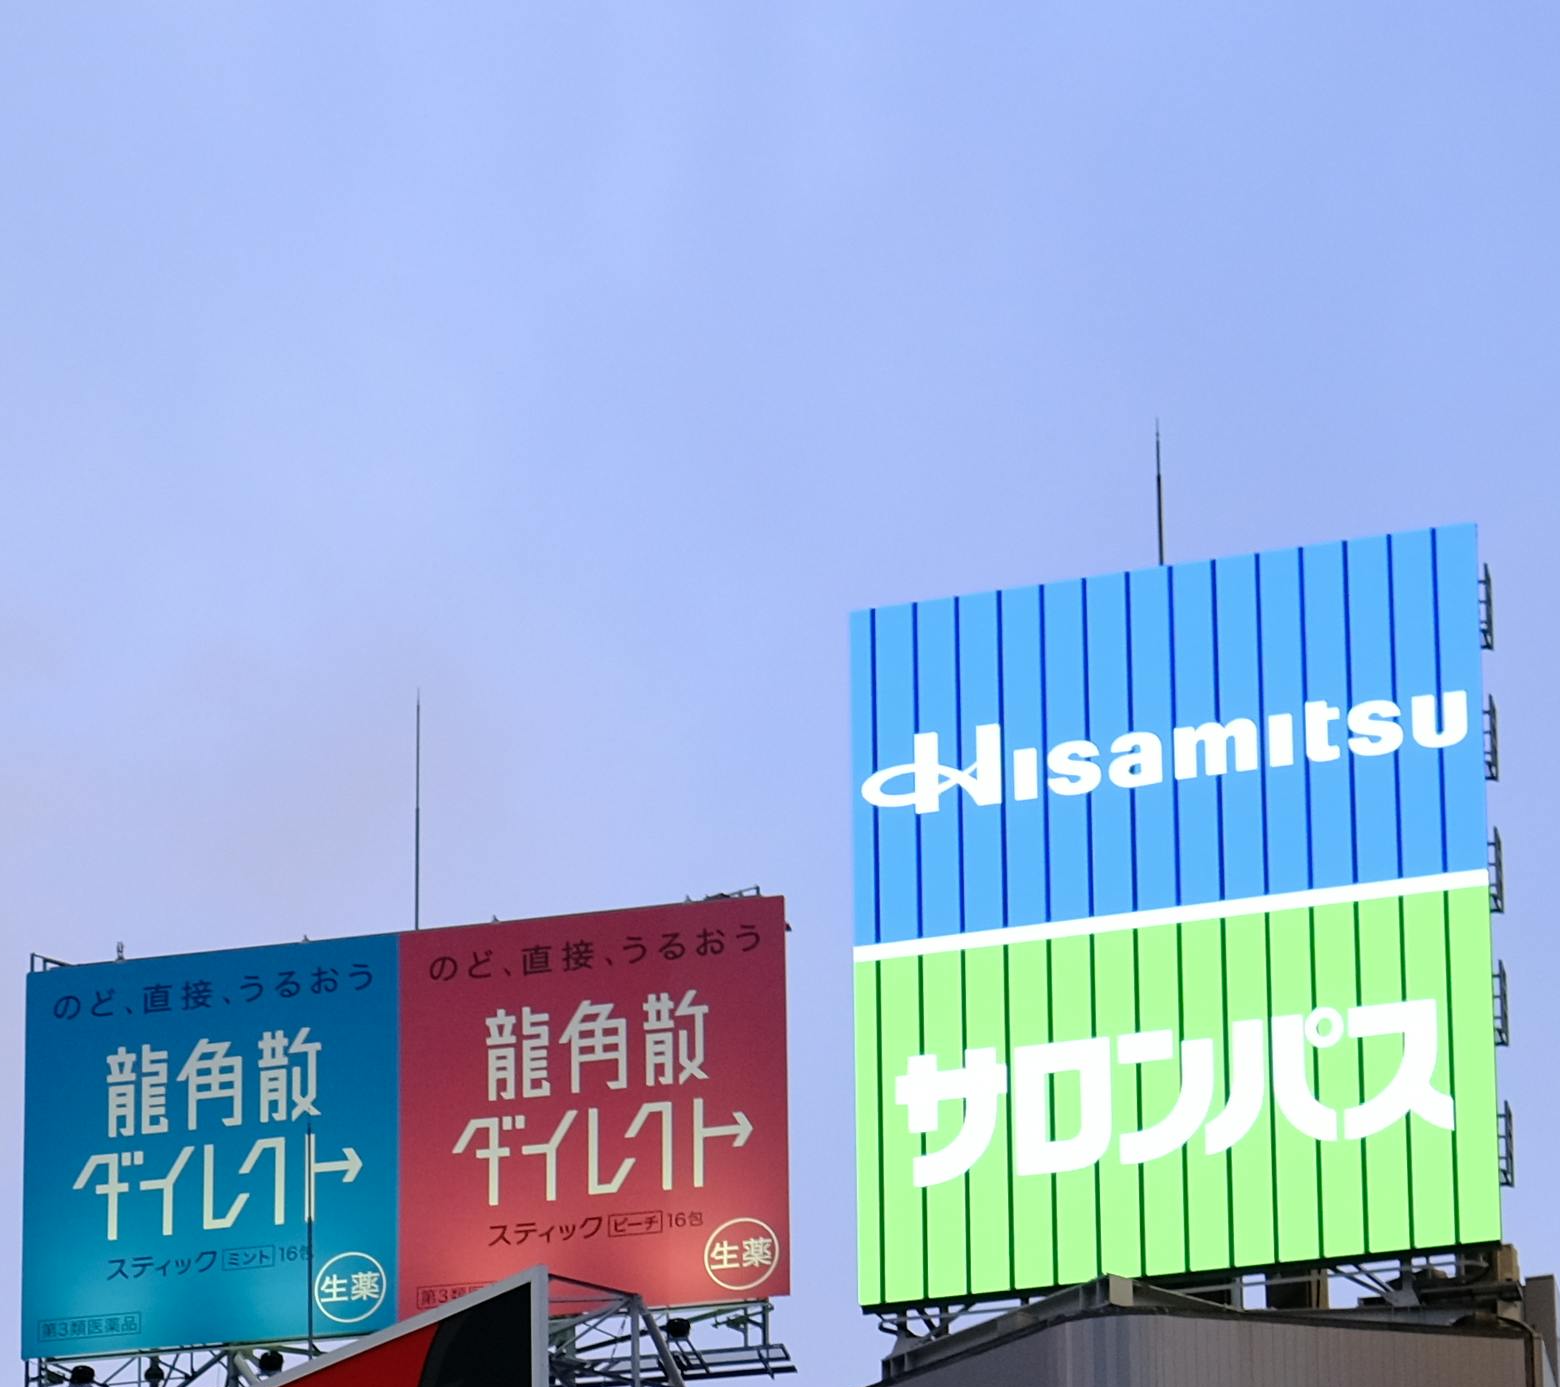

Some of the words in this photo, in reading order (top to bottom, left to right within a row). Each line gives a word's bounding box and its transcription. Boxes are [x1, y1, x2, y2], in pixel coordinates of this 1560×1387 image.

[861, 692, 1470, 814] Hisamitsu
[428, 924, 763, 982] のど、直接、うるおう
[52, 961, 376, 1023] のど、直接、うるおう
[485, 990, 711, 1102] 龍角散
[106, 1026, 322, 1139] 龍角散
[894, 999, 1455, 1189] サロンパス
[451, 1100, 754, 1207] ダイレクト
[489, 1215, 602, 1248] スティック
[710, 1235, 773, 1272] 生薬
[106, 1250, 217, 1282] スティック
[319, 1272, 382, 1303] 生薬
[40, 1313, 139, 1338] 第3類医薬品
